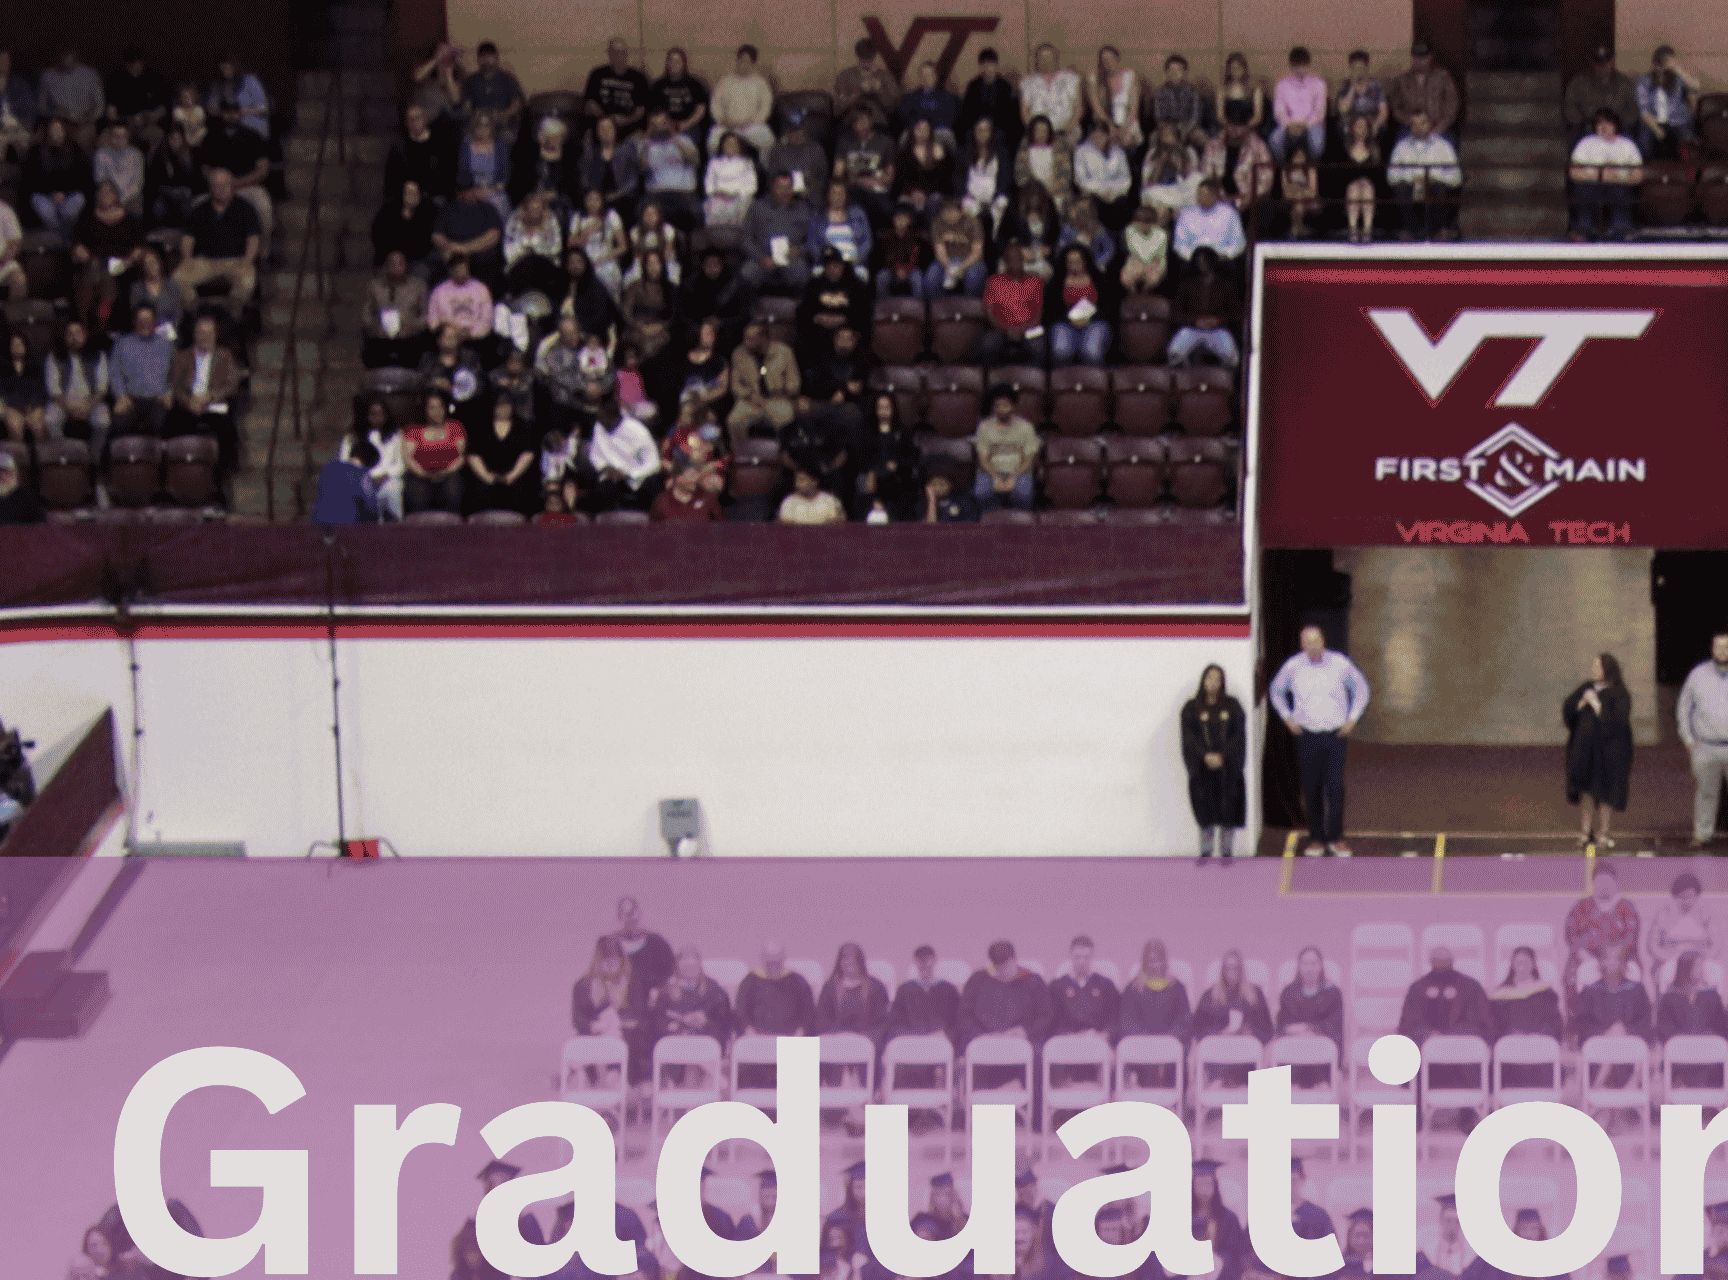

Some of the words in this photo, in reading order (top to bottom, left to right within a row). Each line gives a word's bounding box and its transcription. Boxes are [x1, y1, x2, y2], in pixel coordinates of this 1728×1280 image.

[861, 16, 1000, 90] VT
[1368, 309, 1655, 407] VT
[1374, 456, 1487, 482] FIRST
[1543, 456, 1647, 482] MAIN
[1395, 520, 1530, 544] VIRGINIA
[1547, 520, 1631, 544] TECH
